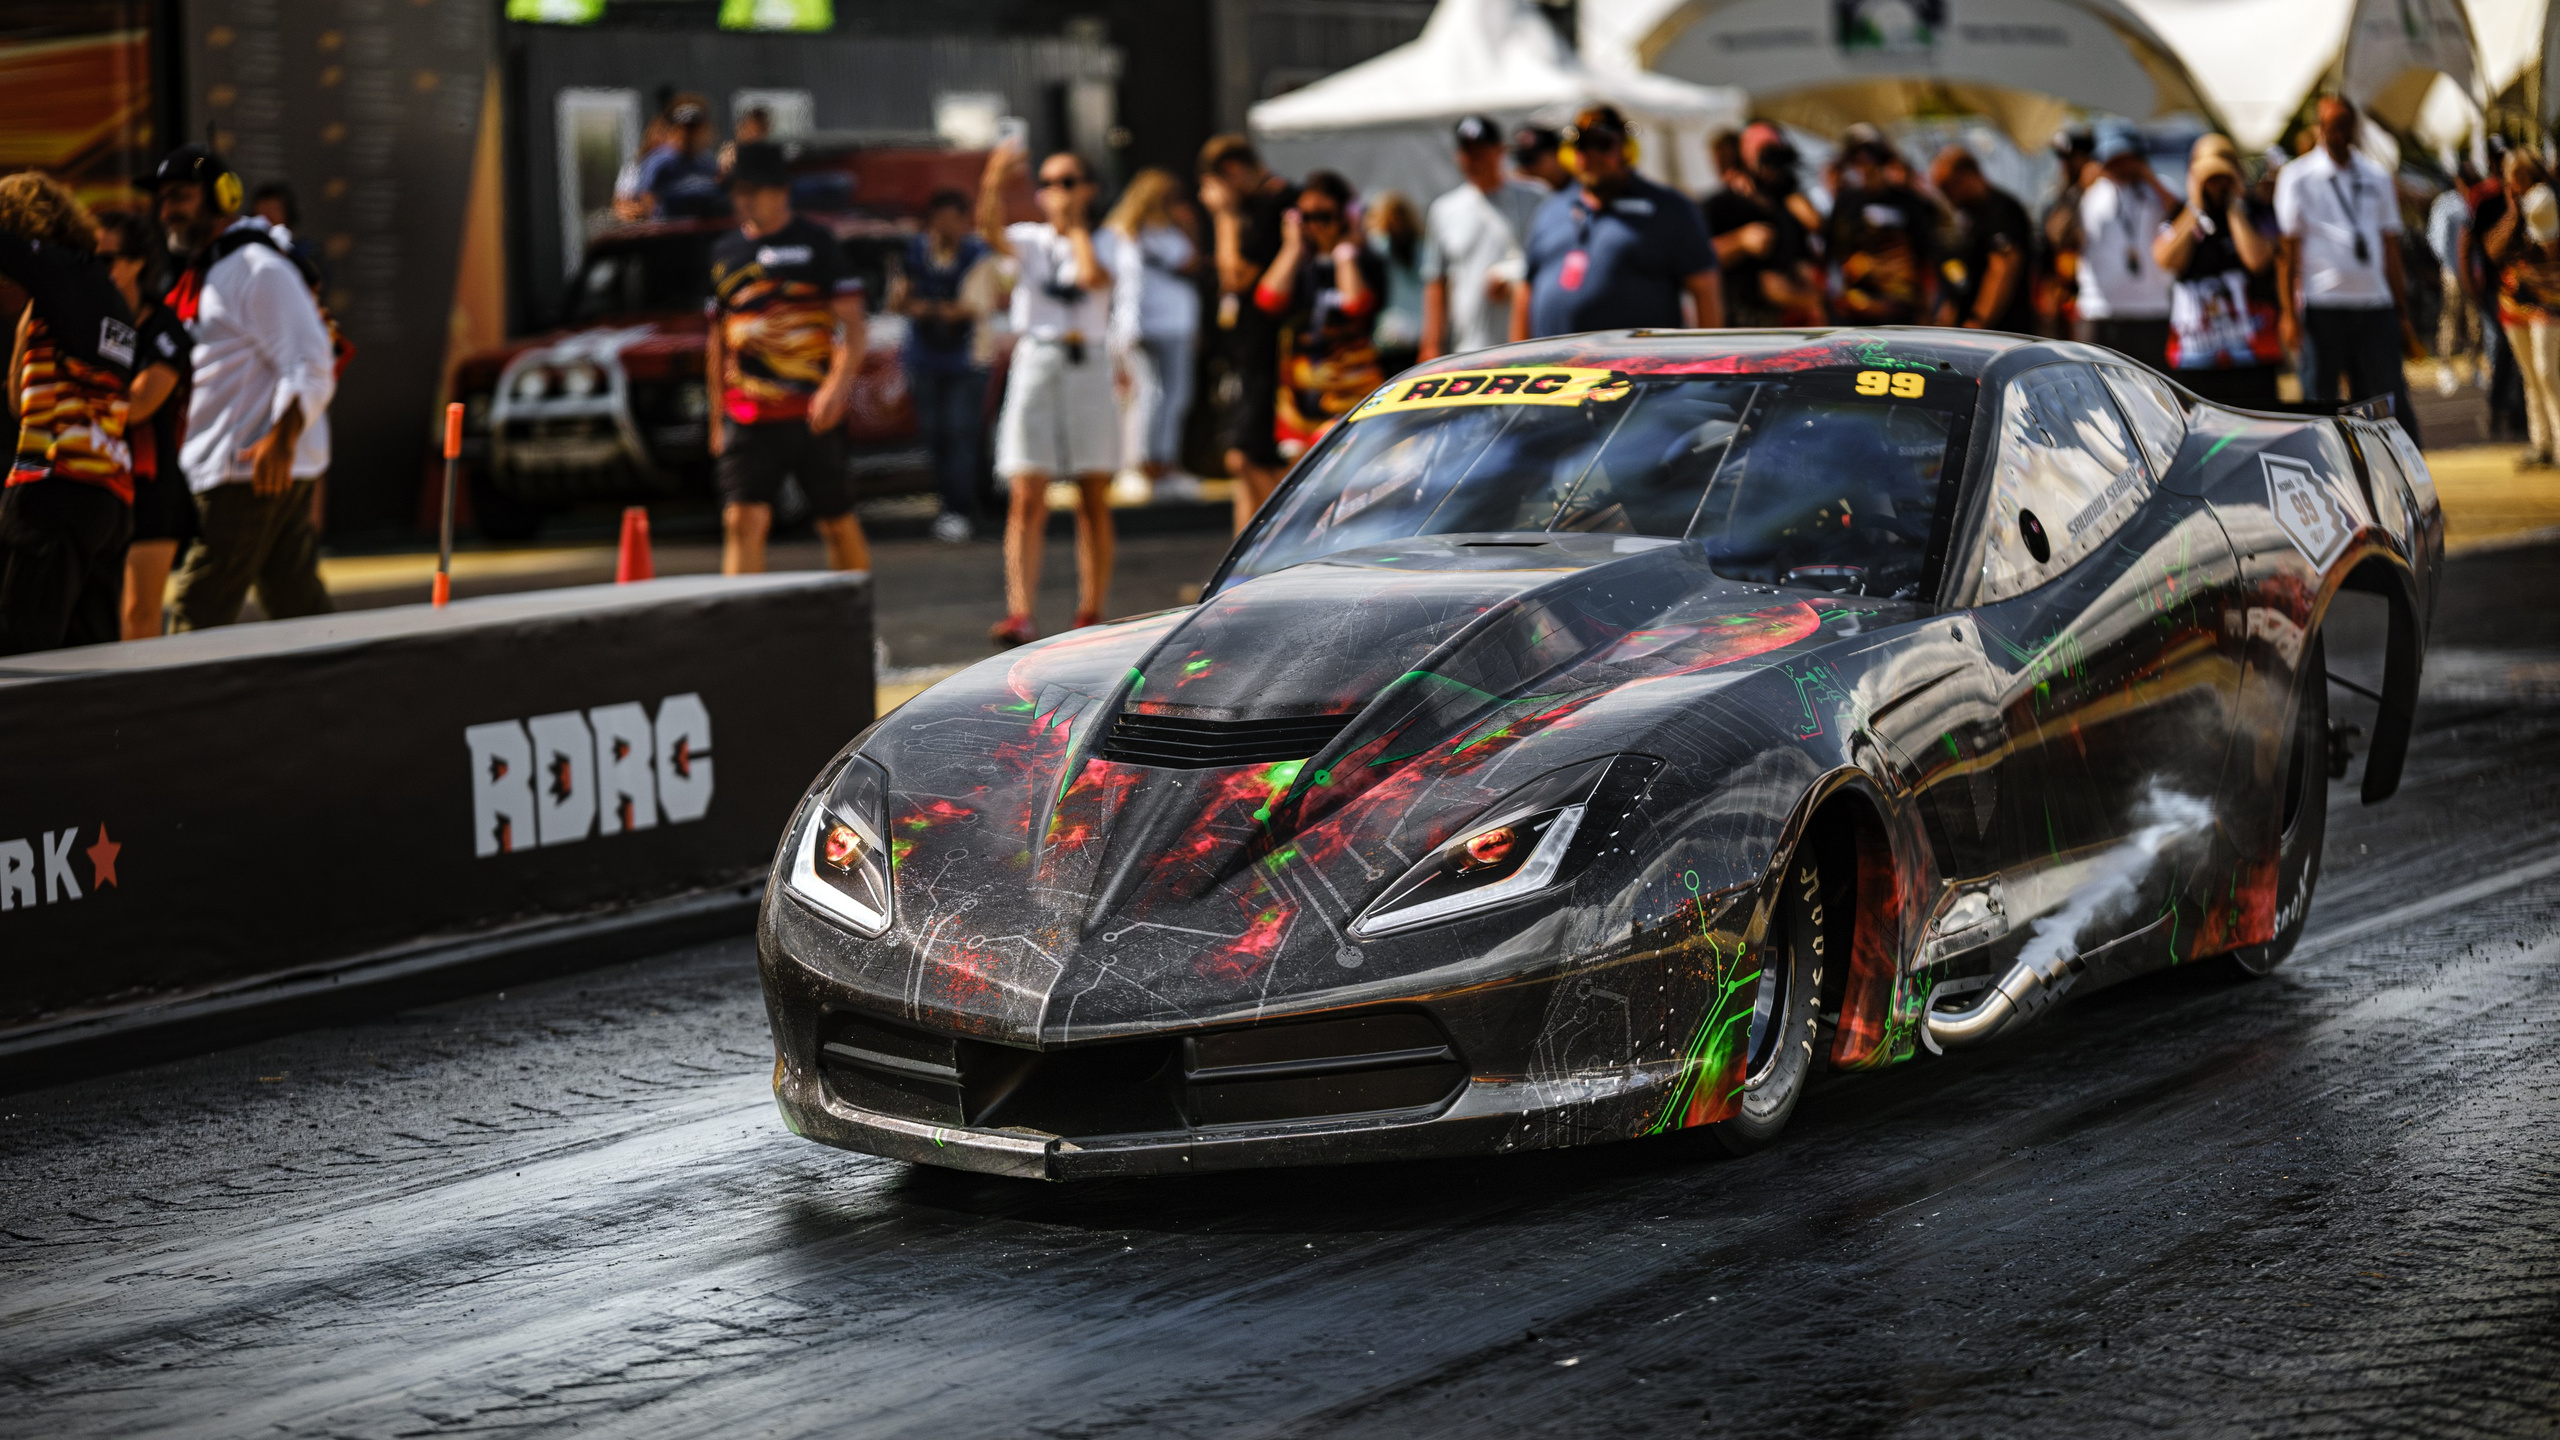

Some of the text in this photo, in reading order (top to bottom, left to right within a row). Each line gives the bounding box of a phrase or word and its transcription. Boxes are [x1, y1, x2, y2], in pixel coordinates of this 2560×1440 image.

[1398, 374, 1573, 403] RDRC
[1855, 370, 1926, 399] 99
[2289, 488, 2321, 528] 99
[464, 692, 715, 858] RDRC
